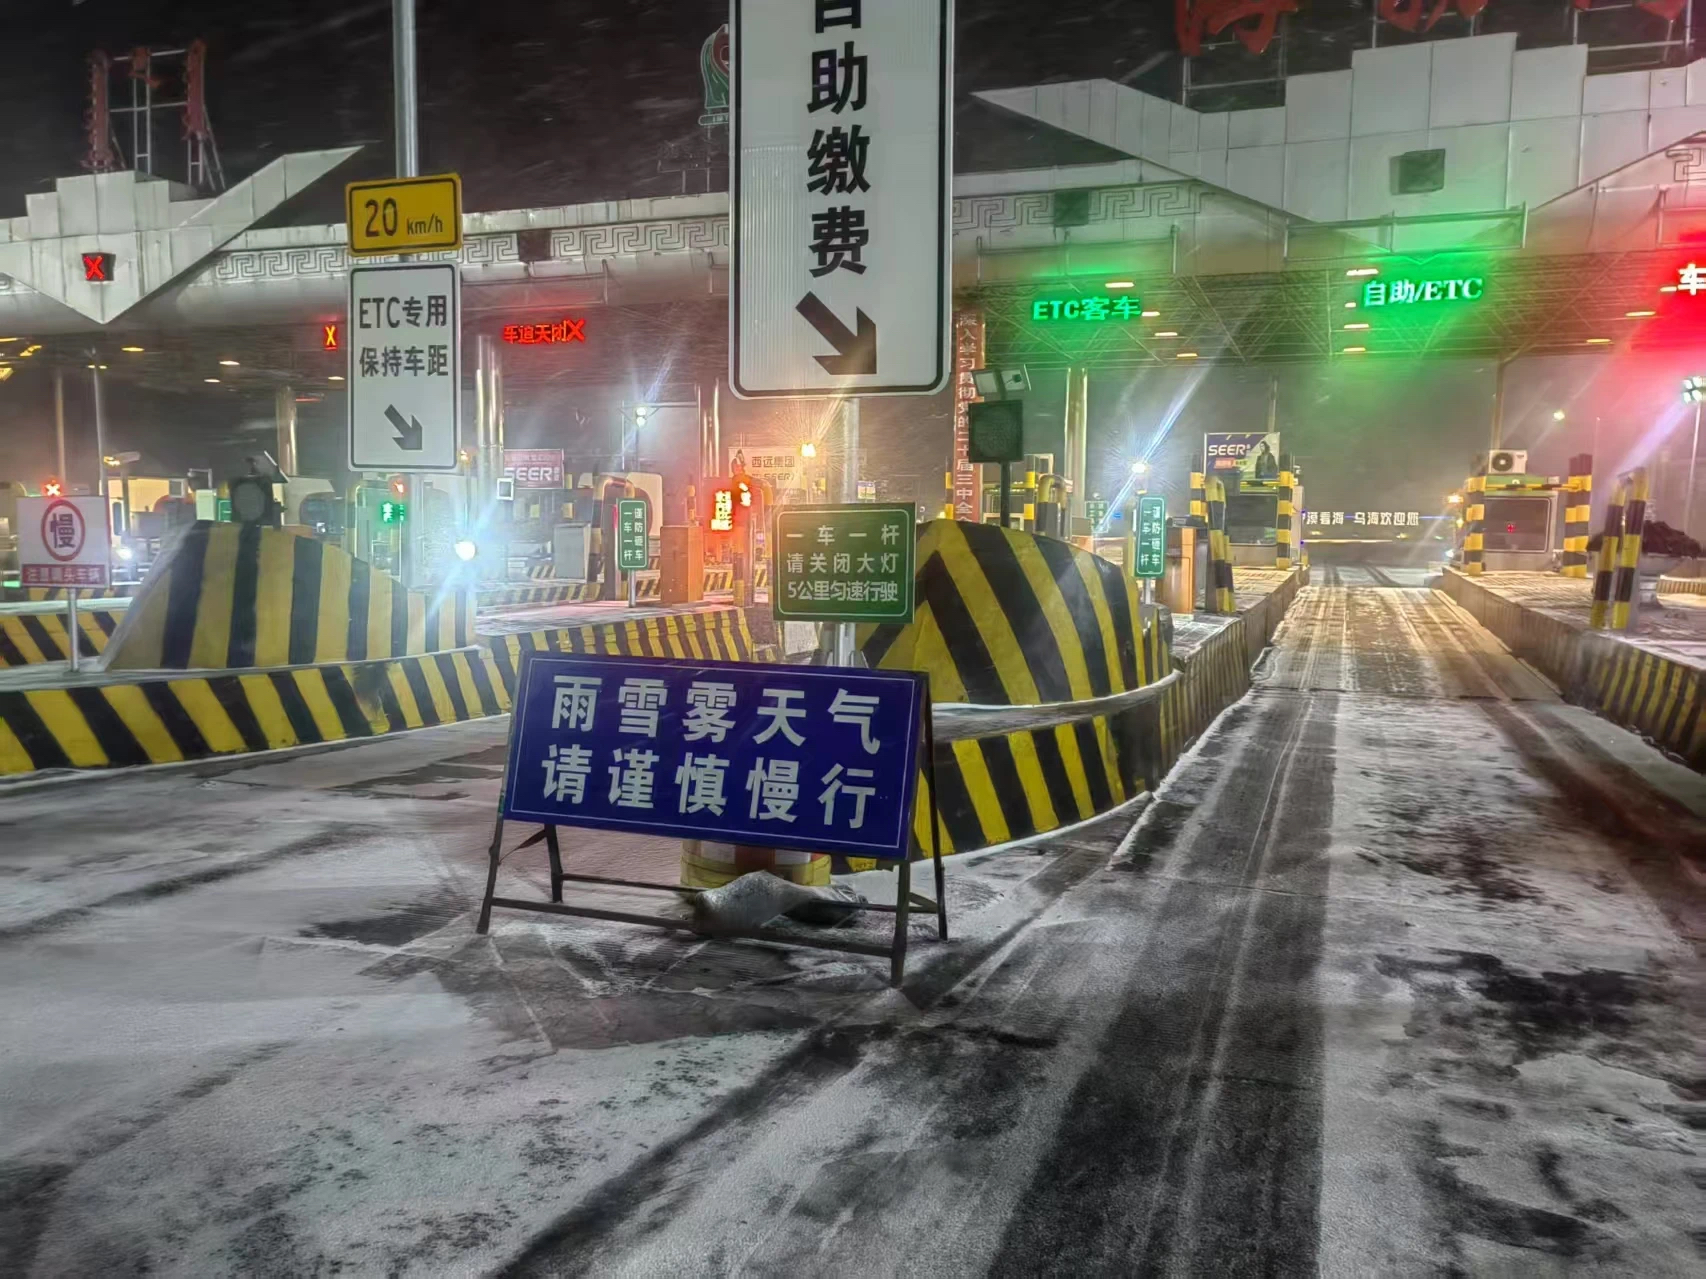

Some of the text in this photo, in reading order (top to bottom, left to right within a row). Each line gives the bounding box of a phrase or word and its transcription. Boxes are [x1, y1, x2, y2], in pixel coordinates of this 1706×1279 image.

[365, 197, 443, 237] 20 km/h
[1364, 278, 1483, 307] 自助/ETC
[359, 295, 447, 328] ETC专用
[1033, 296, 1141, 321] ETC客车
[359, 345, 448, 377] 保持车距
[1208, 444, 1245, 456] SEER
[504, 467, 552, 481] SEER
[50, 513, 75, 548] 慢
[786, 524, 900, 545] 一车一杆
[787, 552, 899, 574] 请关闭大灯
[788, 580, 899, 602] 5公里匀速行驶
[551, 674, 881, 756] 雨雪雾天气
[541, 743, 876, 829] 请谨慎慢行
